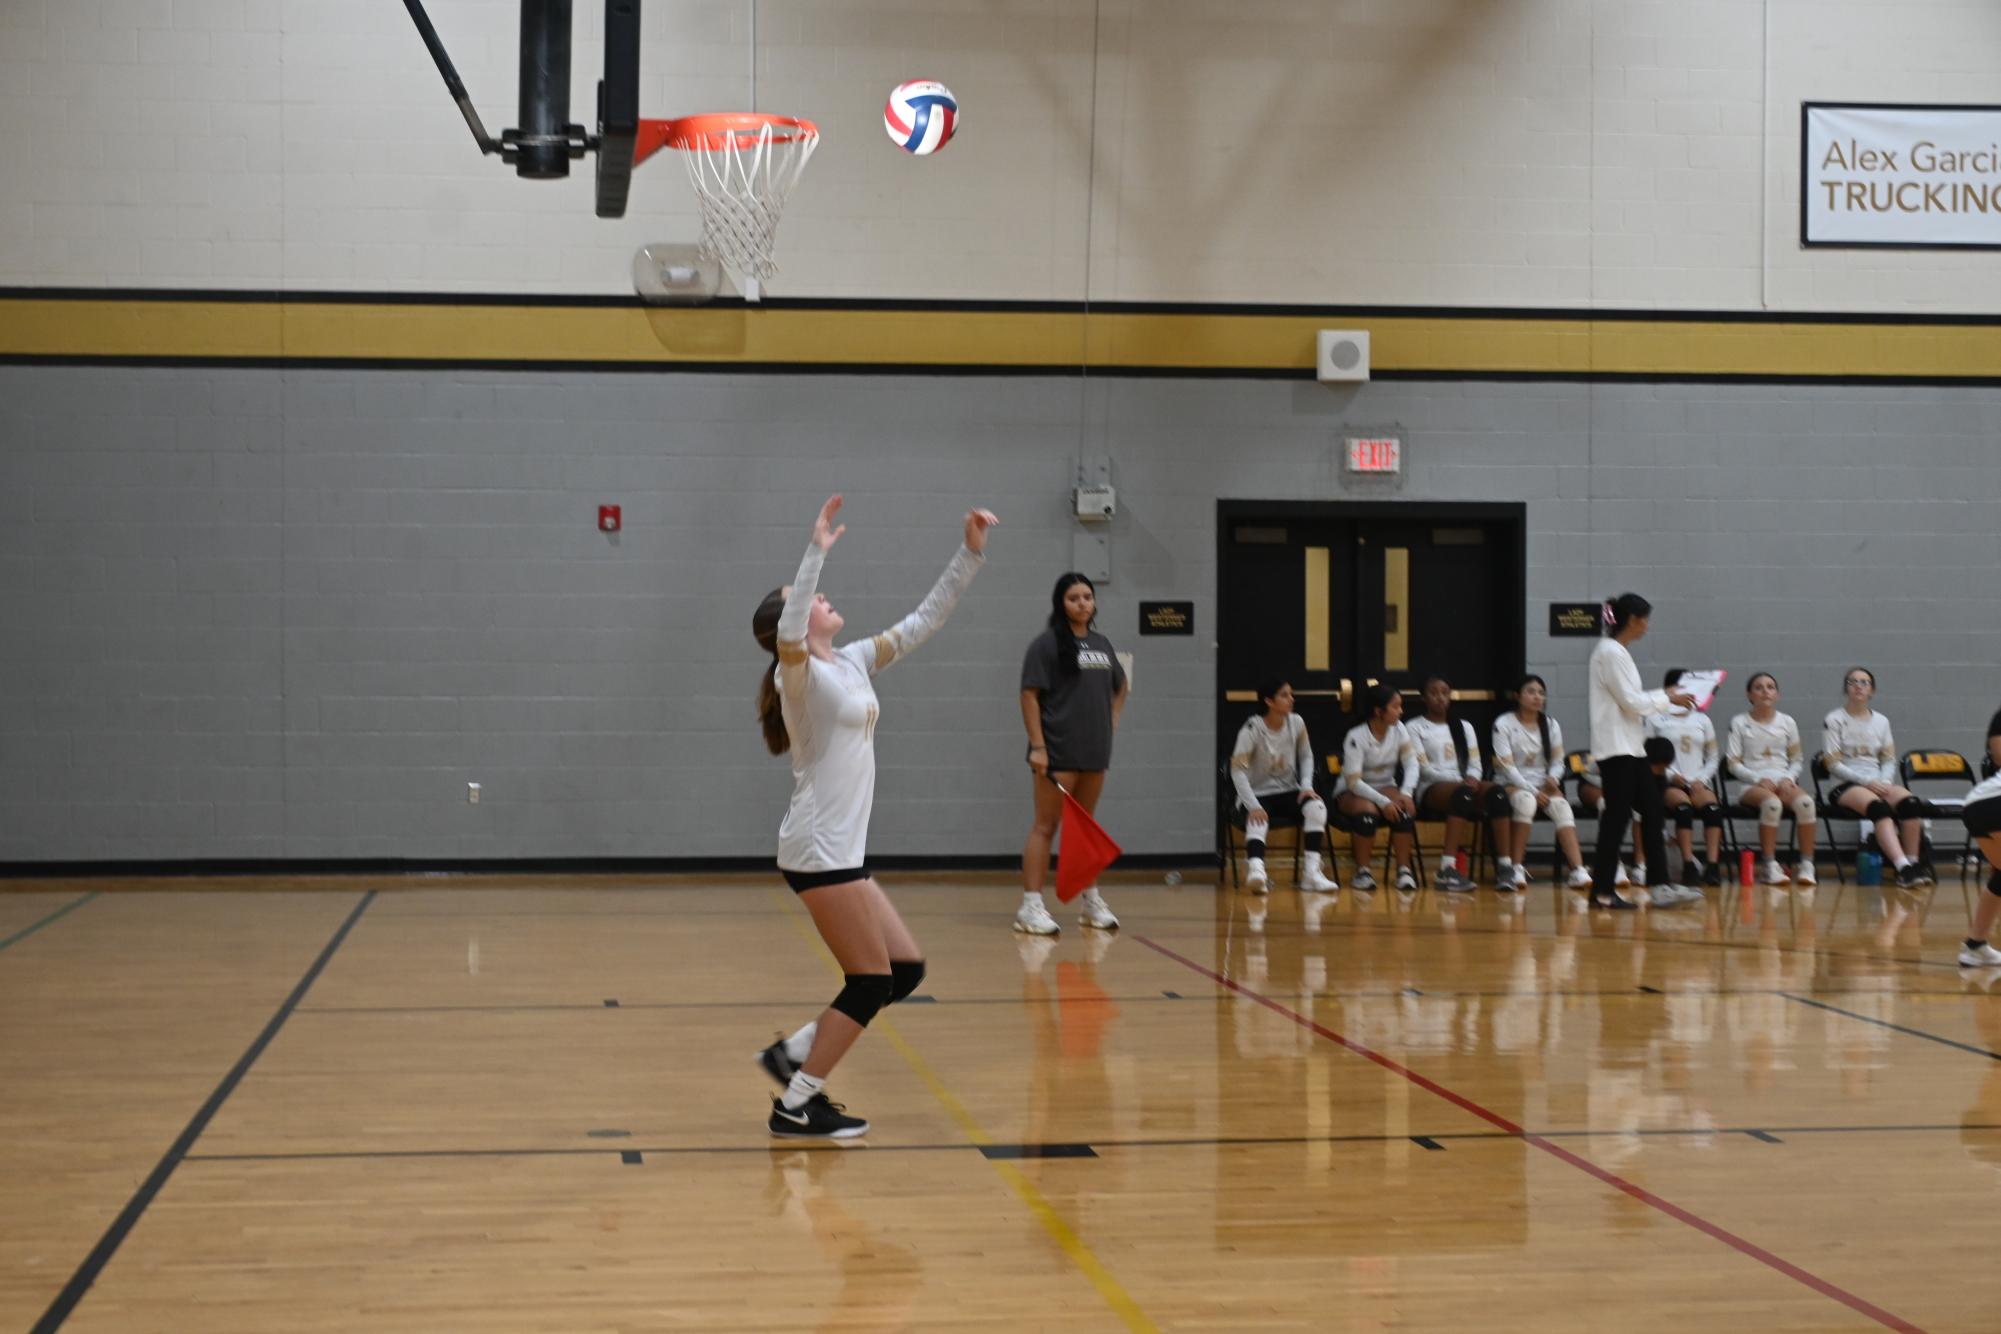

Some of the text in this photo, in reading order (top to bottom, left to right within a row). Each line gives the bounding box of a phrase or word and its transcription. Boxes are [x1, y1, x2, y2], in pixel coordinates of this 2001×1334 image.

[1821, 138, 2001, 174] Alex Garci
[1360, 441, 1391, 469] EXIT
